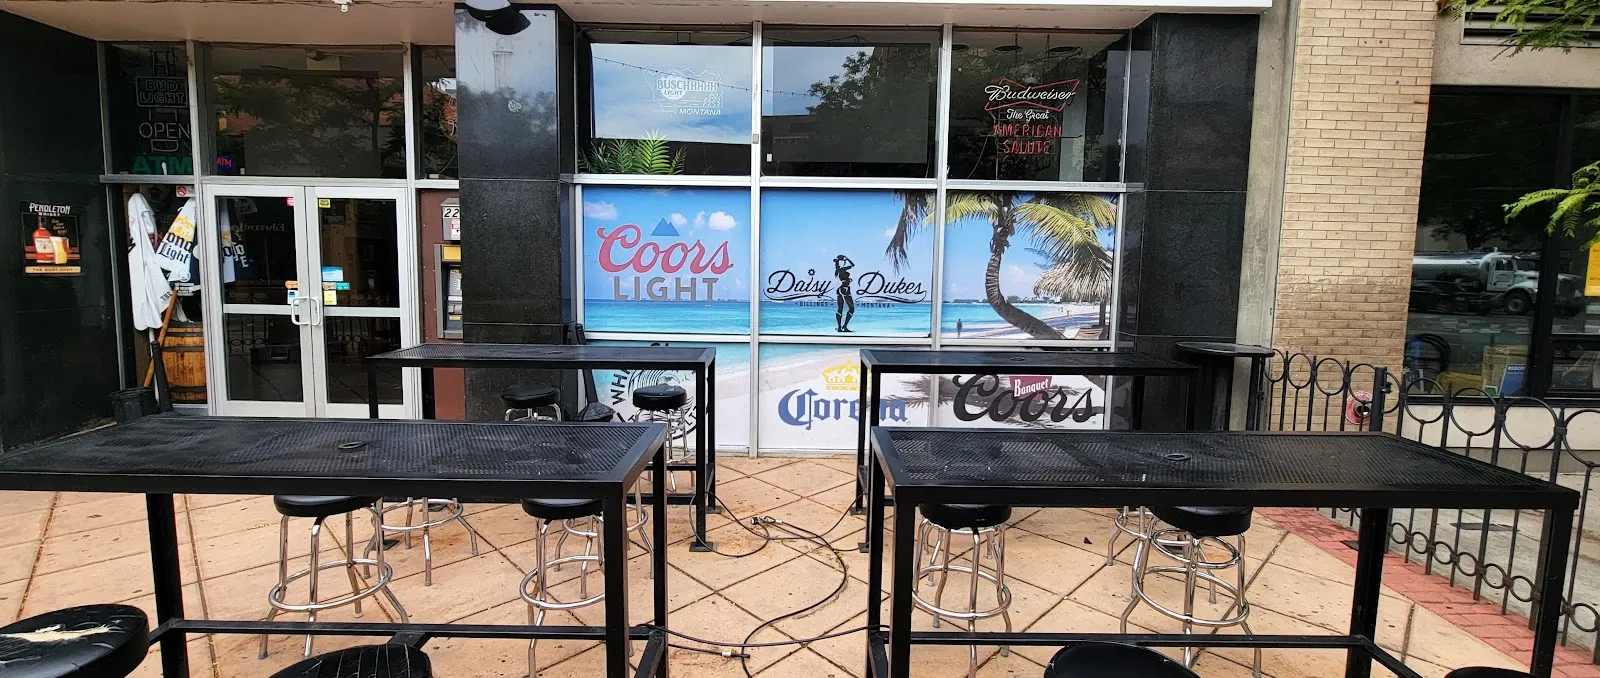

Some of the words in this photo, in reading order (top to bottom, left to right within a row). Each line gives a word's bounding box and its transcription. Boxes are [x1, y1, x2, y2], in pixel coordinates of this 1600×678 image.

[145, 80, 178, 91] BUD
[985, 85, 1076, 101] Budweiser
[140, 92, 185, 104] LIGHT
[1007, 109, 1023, 119] The
[1025, 109, 1049, 123] Great
[139, 122, 190, 138] OPEN
[994, 124, 1062, 137] AMERICAN
[1003, 140, 1050, 154] SALUTE
[131, 155, 193, 175] ATM
[216, 157, 232, 167] ATM
[29, 202, 71, 215] PENDLETON
[596, 224, 734, 274] Coors
[613, 276, 720, 301] LIGHT
[766, 268, 836, 298] Daisy
[856, 270, 927, 296] Dukes
[1014, 378, 1050, 398] Banquet
[952, 373, 1097, 423] Coors
